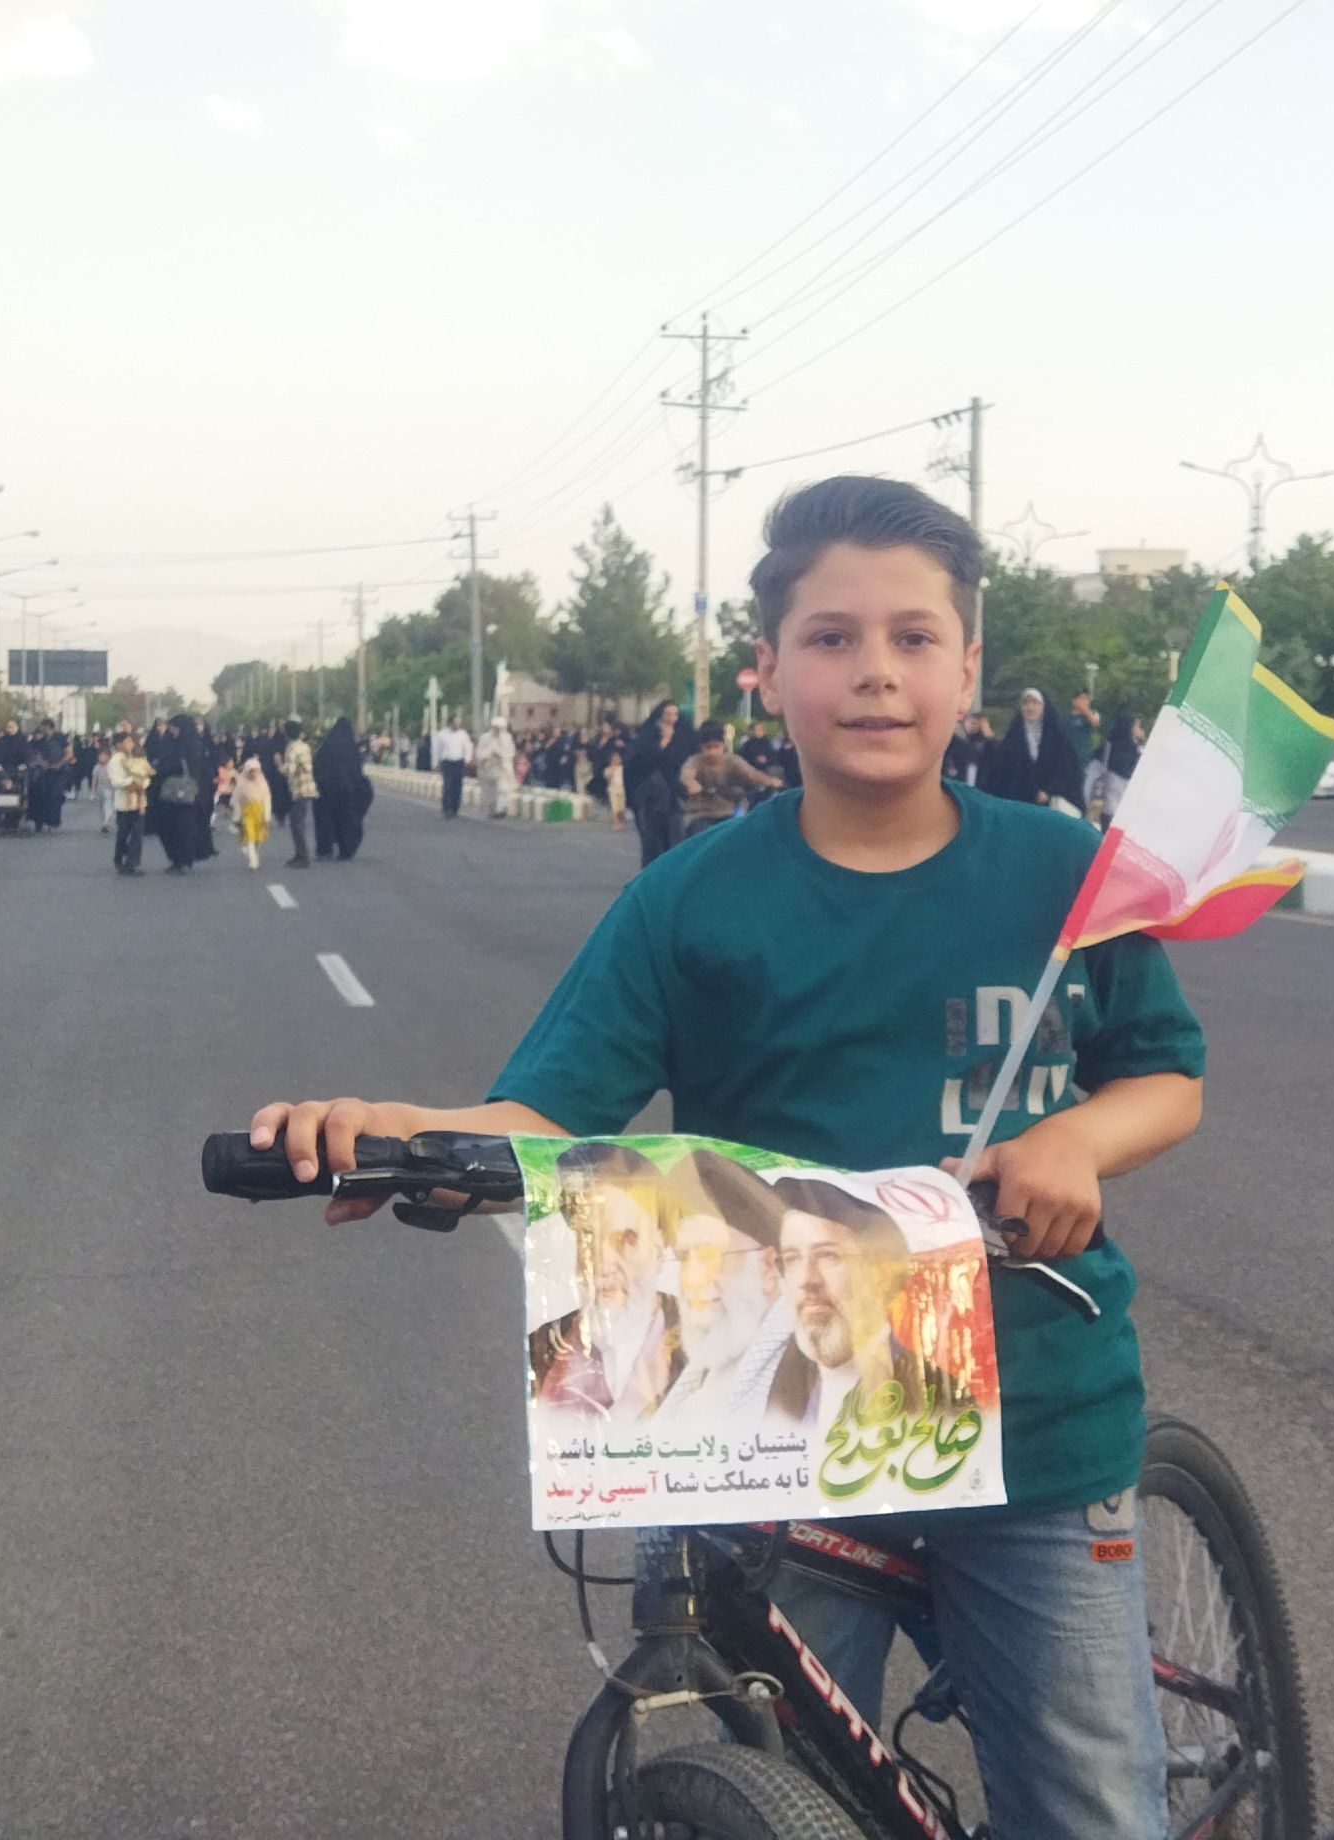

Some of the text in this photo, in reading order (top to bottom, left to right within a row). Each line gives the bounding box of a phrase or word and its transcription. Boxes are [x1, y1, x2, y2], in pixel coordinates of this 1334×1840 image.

[602, 1434, 653, 1465] فقیه
[658, 1435, 730, 1463] ولایت
[738, 1432, 808, 1462] پشتیبان
[598, 1470, 659, 1503] آسیبی
[665, 1471, 699, 1493] شما
[704, 1470, 771, 1493] مملکت
[775, 1472, 792, 1496] به
[796, 1466, 810, 1489] تا
